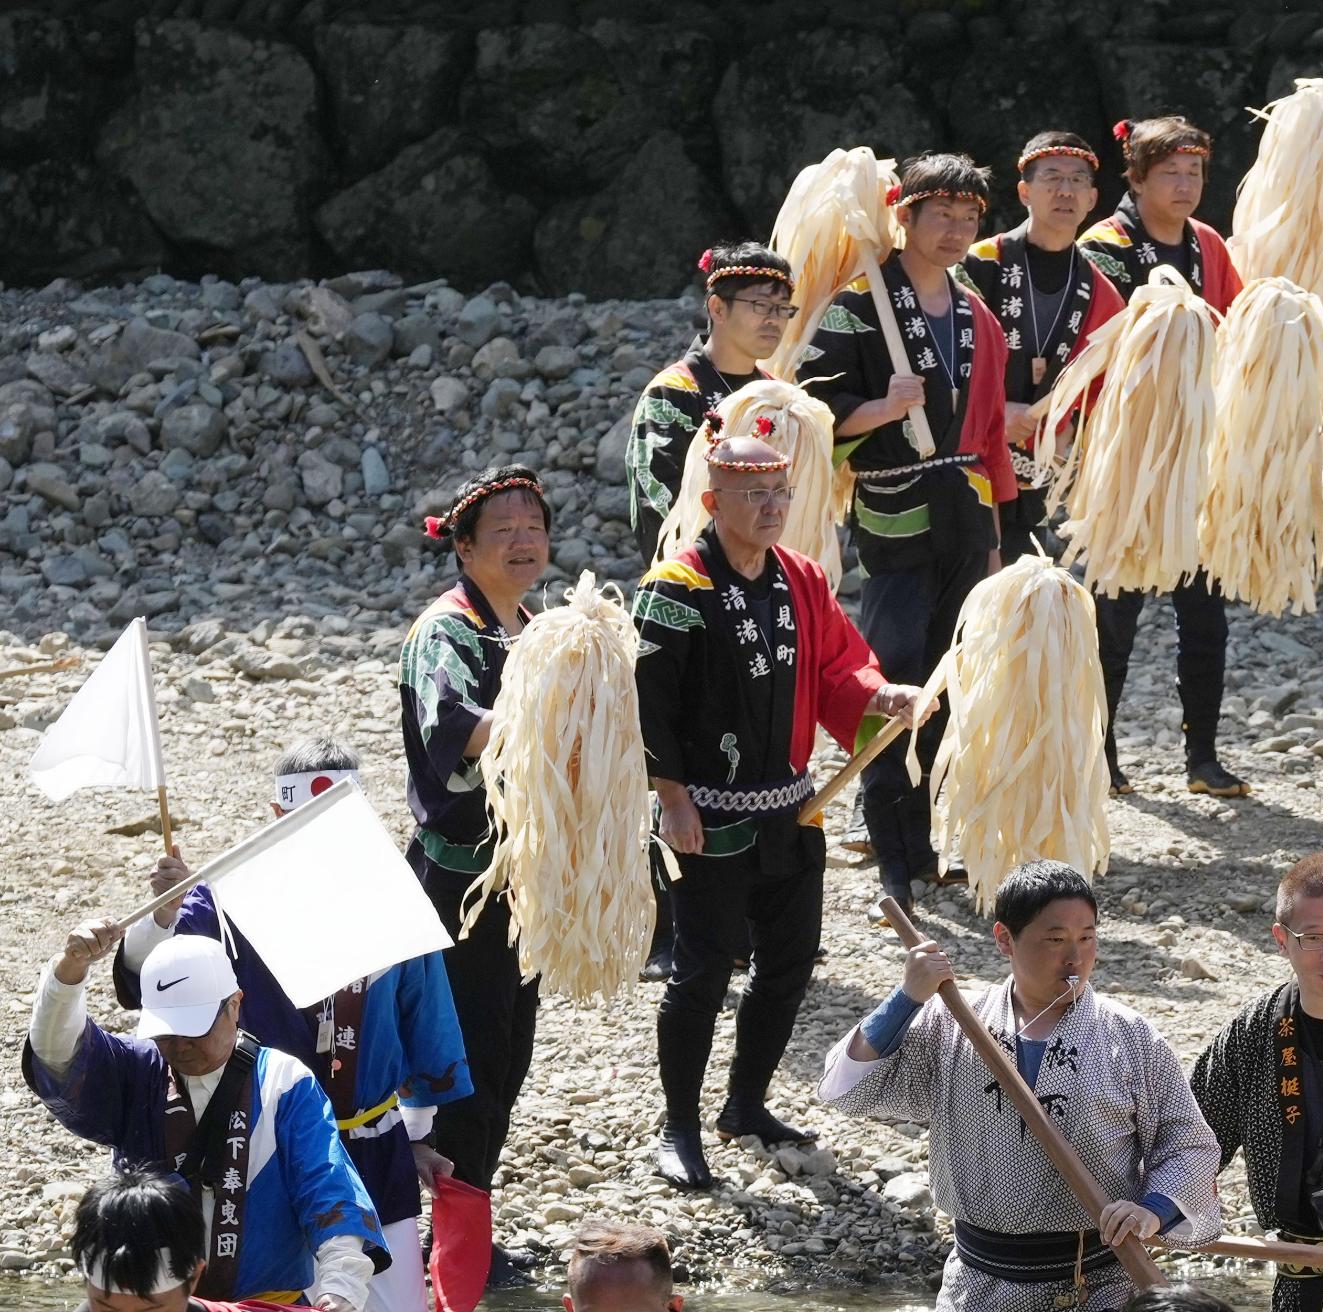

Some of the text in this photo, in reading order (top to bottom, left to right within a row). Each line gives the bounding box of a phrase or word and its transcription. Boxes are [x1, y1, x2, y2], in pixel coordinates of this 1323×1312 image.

[892, 285, 939, 371] 清渚連
[1000, 262, 1025, 351] 清渚連
[1056, 281, 1092, 363] 二見町
[720, 583, 772, 680] 清渚連
[772, 572, 797, 666] 二見町
[281, 784, 297, 803] 町
[216, 1109, 248, 1260] 松下奉曳団
